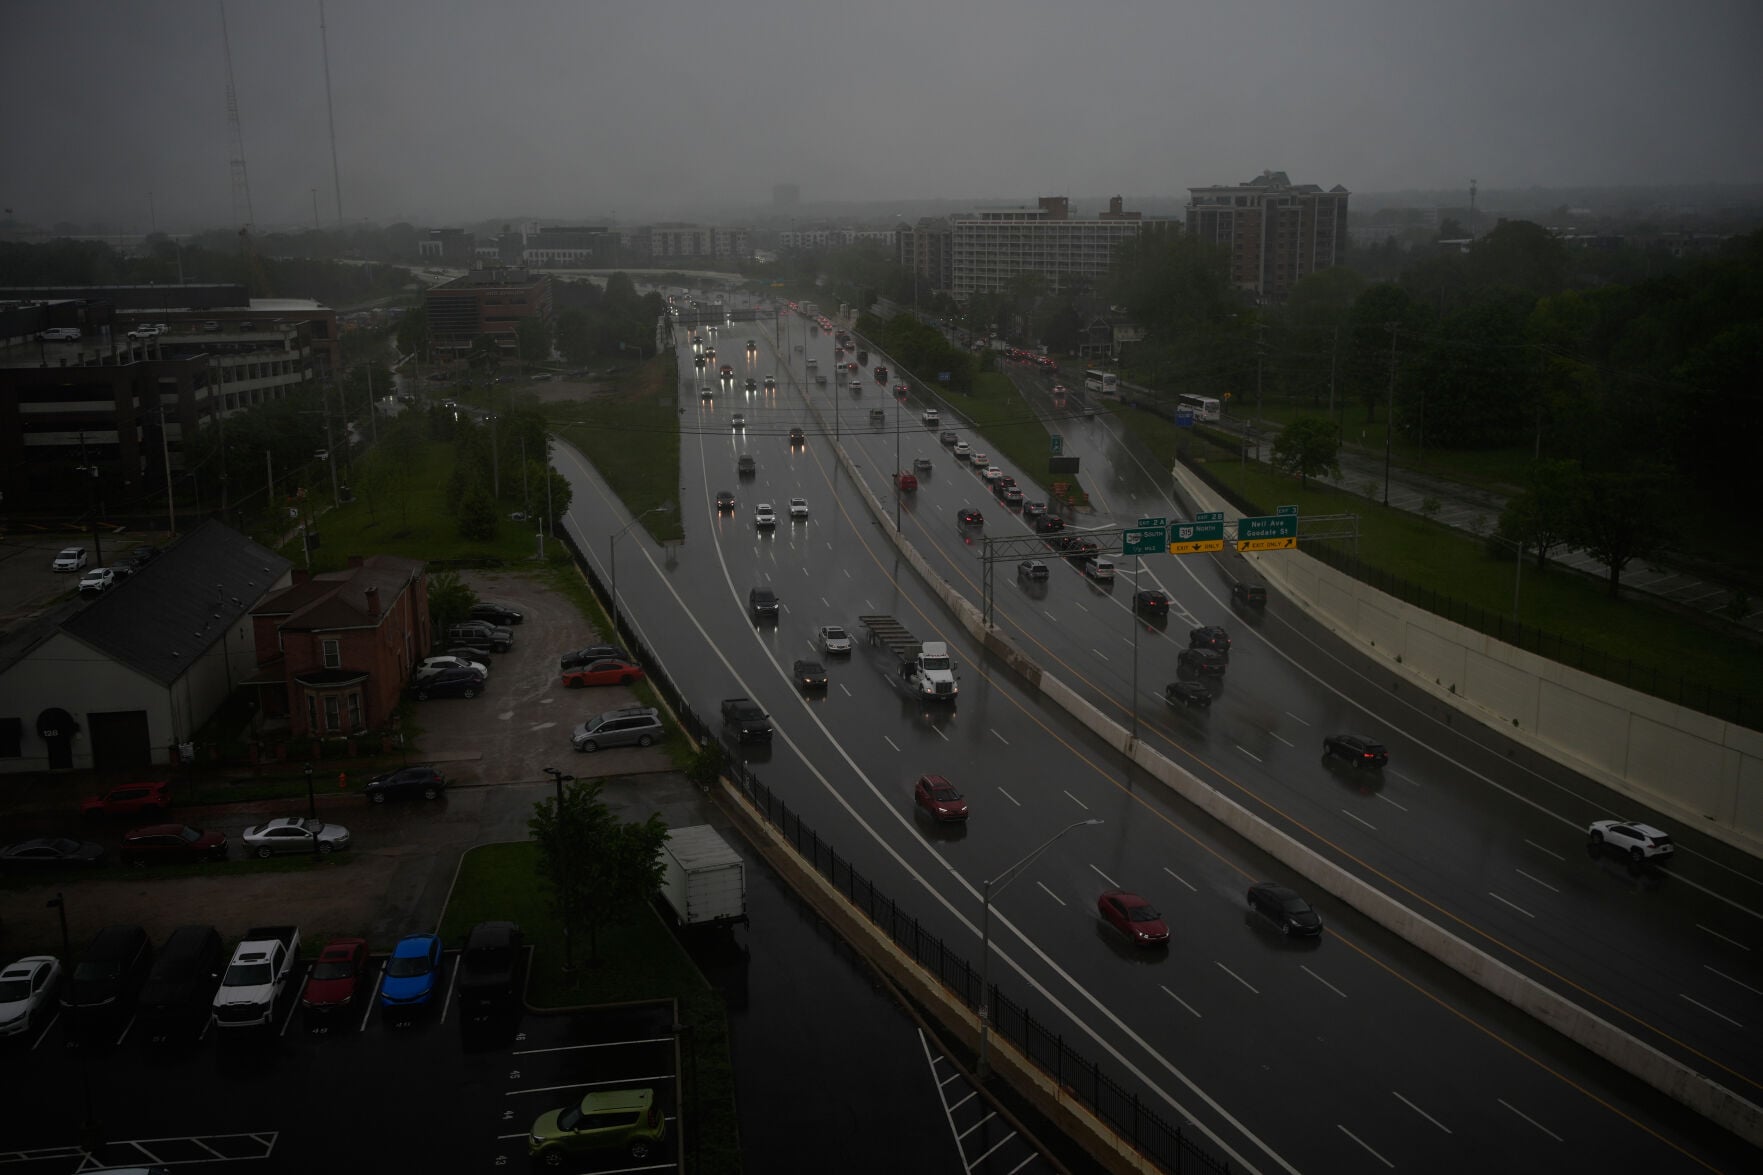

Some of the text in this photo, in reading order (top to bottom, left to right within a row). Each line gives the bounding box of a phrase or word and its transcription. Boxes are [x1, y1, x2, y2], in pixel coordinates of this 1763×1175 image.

[1251, 520, 1266, 528] Neil
[1181, 528, 1192, 536] 315
[1246, 529, 1276, 537] Goodale
